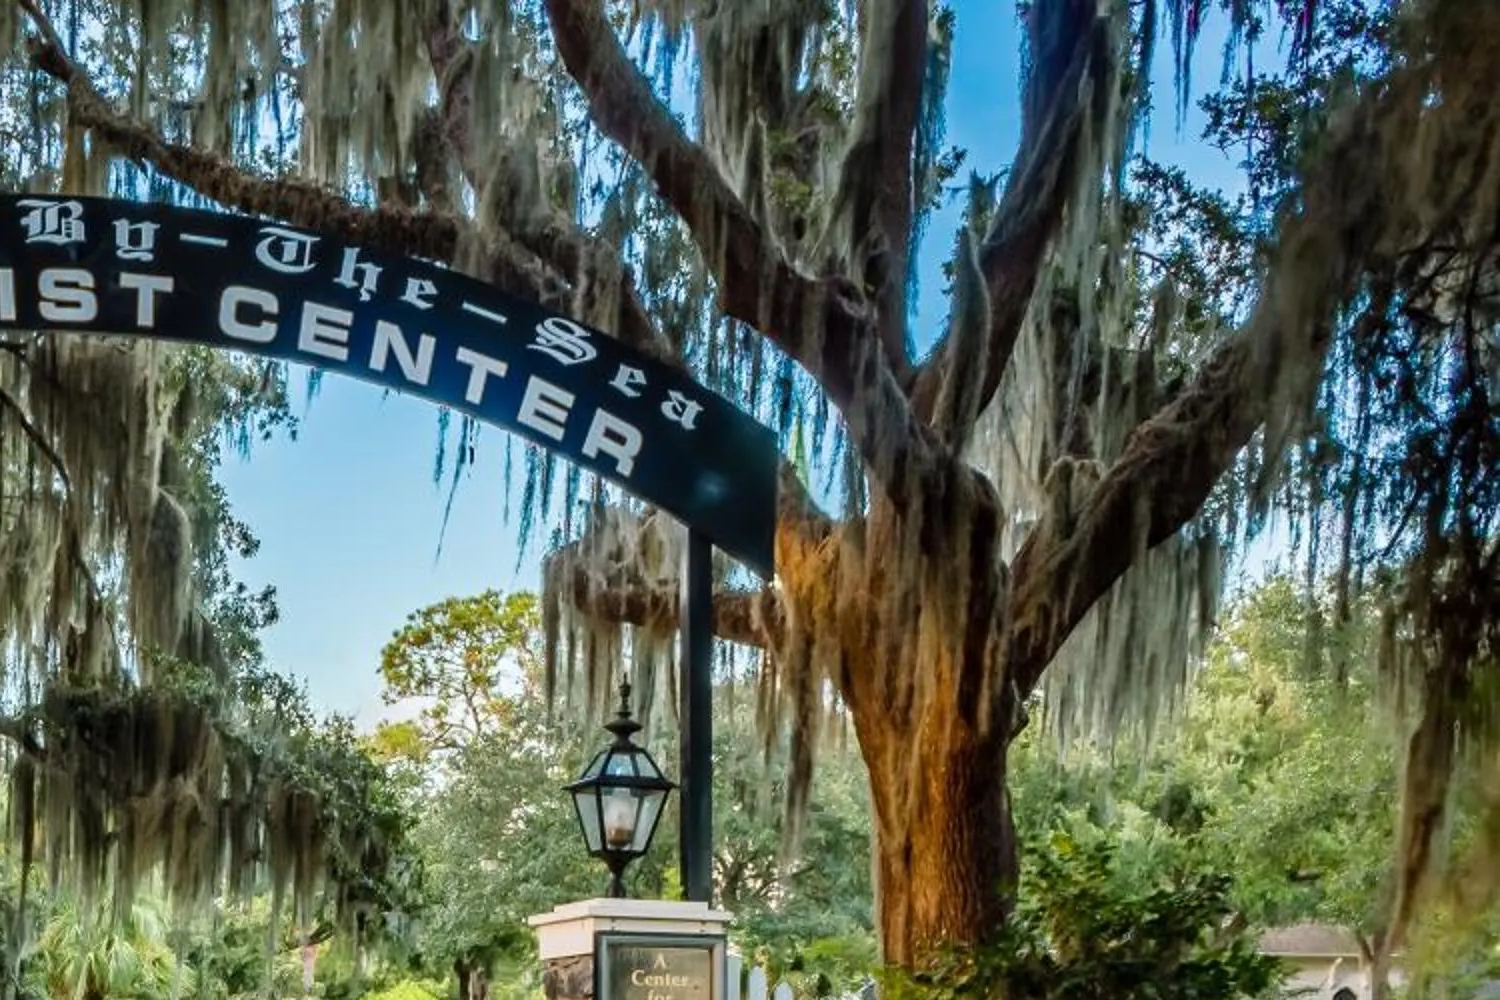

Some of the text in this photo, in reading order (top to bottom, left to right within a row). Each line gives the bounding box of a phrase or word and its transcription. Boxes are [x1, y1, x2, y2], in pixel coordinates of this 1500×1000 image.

[218, 286, 643, 478] CENTER
[653, 953, 668, 969] A
[631, 969, 690, 988] Center
